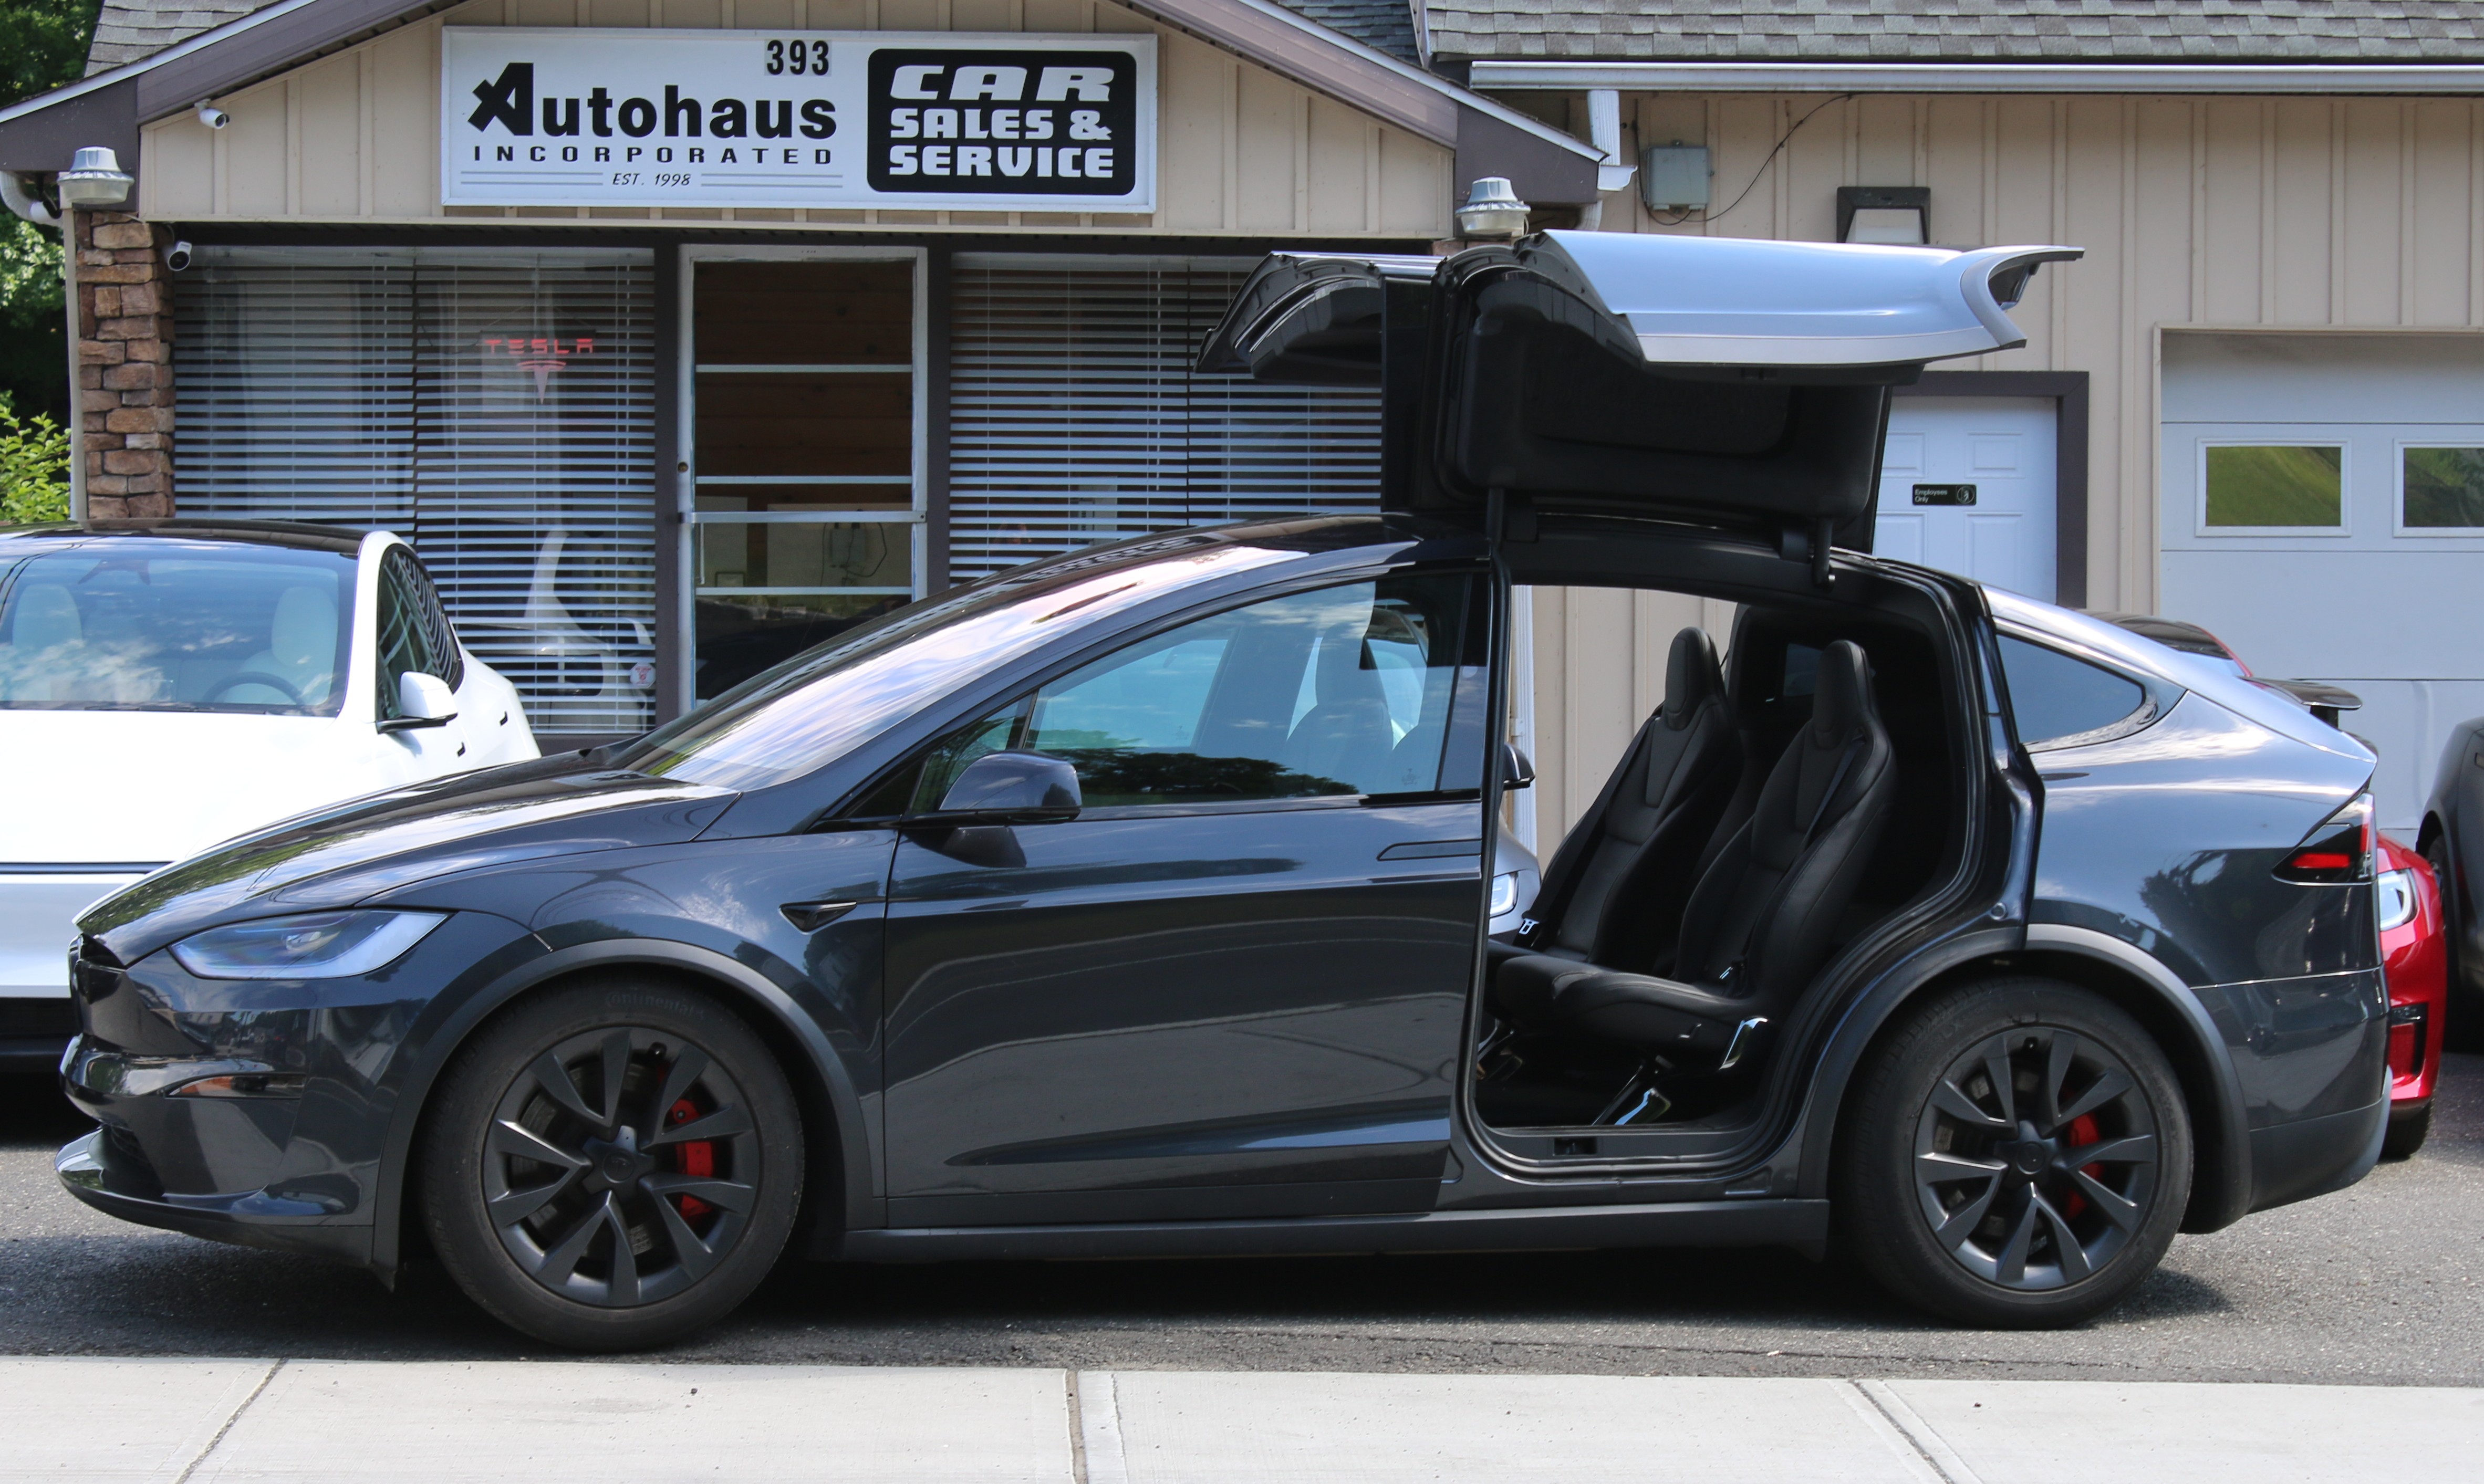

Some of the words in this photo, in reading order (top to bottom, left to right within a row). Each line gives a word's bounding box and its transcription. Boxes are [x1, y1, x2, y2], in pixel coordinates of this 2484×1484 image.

[767, 40, 829, 76] 393
[890, 66, 1115, 102] CAR
[468, 62, 837, 139] Autohaus
[890, 108, 1054, 140] SALES
[1069, 110, 1112, 140] &
[474, 146, 831, 164] INCORPORATED
[889, 145, 1114, 178] SERVICE
[612, 173, 645, 185] EST.
[655, 173, 691, 187] 1998
[485, 338, 593, 355] TESLA
